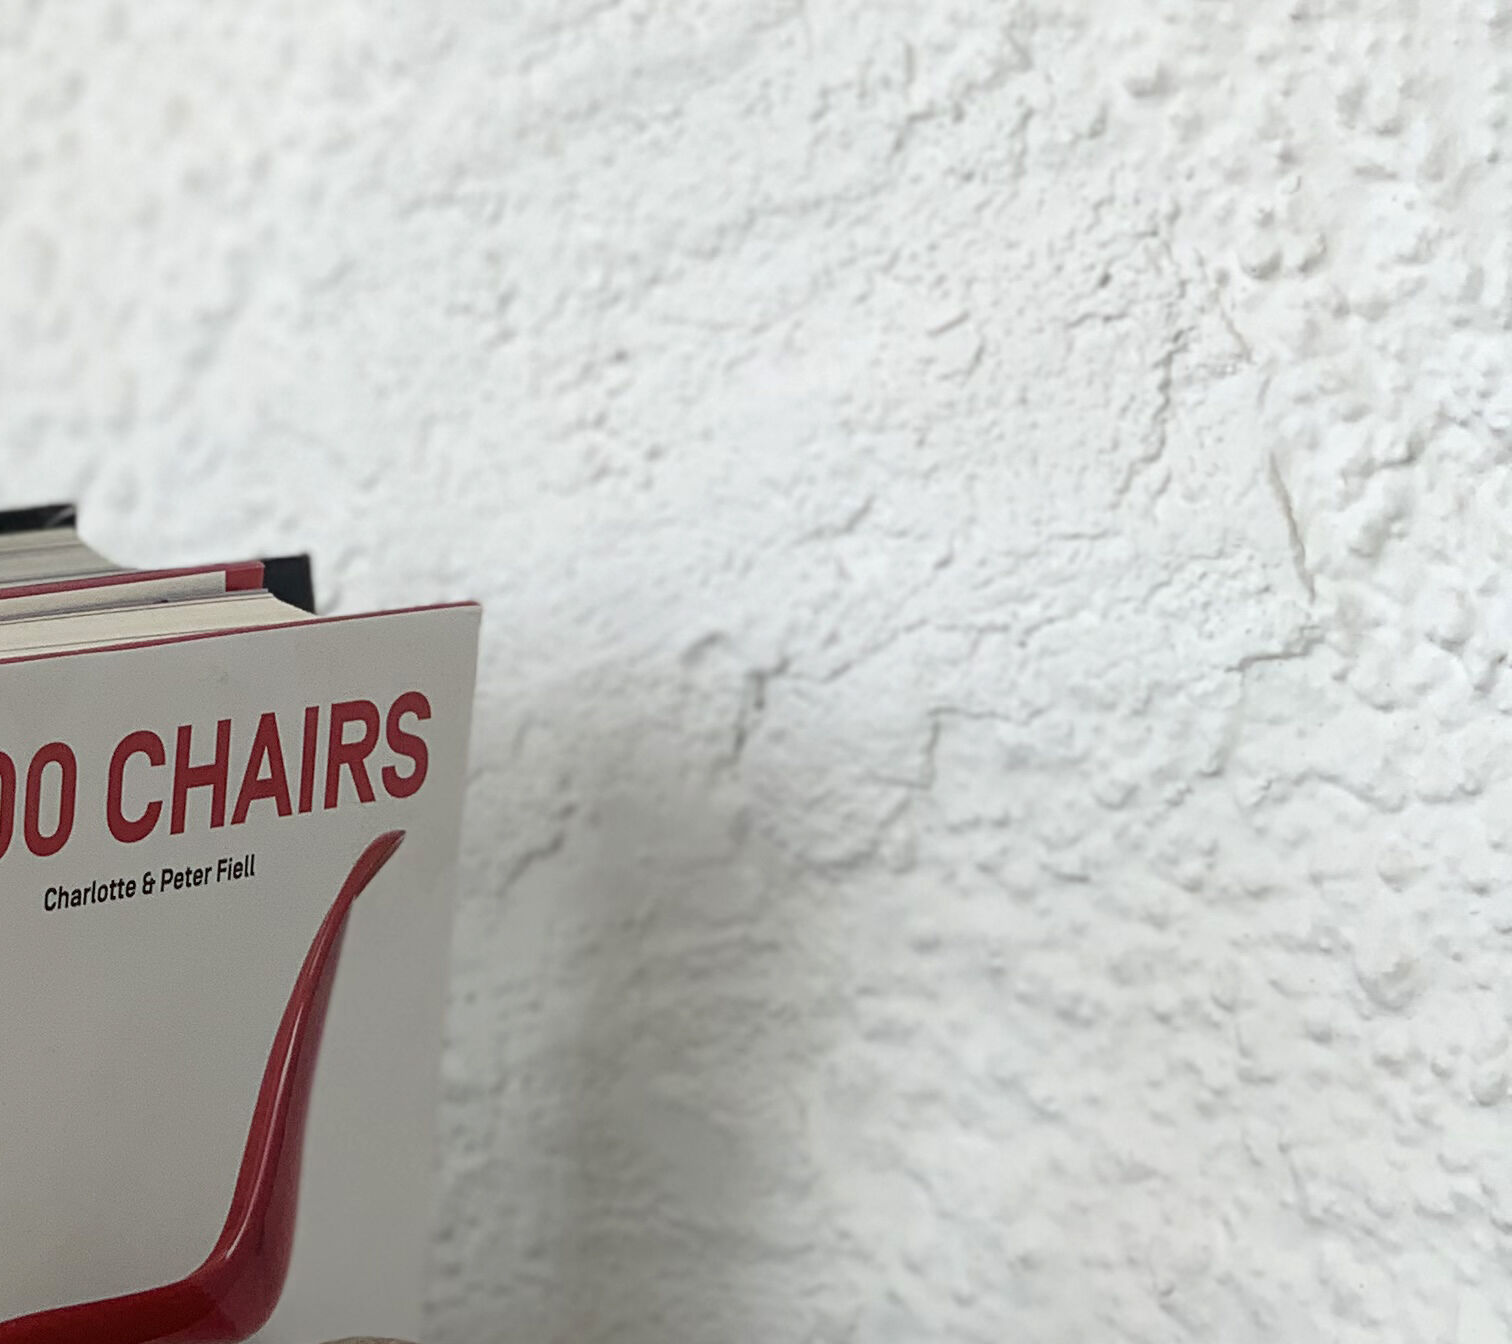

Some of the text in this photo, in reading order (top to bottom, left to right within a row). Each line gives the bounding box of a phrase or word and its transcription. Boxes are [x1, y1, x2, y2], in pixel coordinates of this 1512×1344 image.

[106, 690, 432, 844] CHAIRS
[44, 854, 255, 911] Charlotte & Peter Fiell
